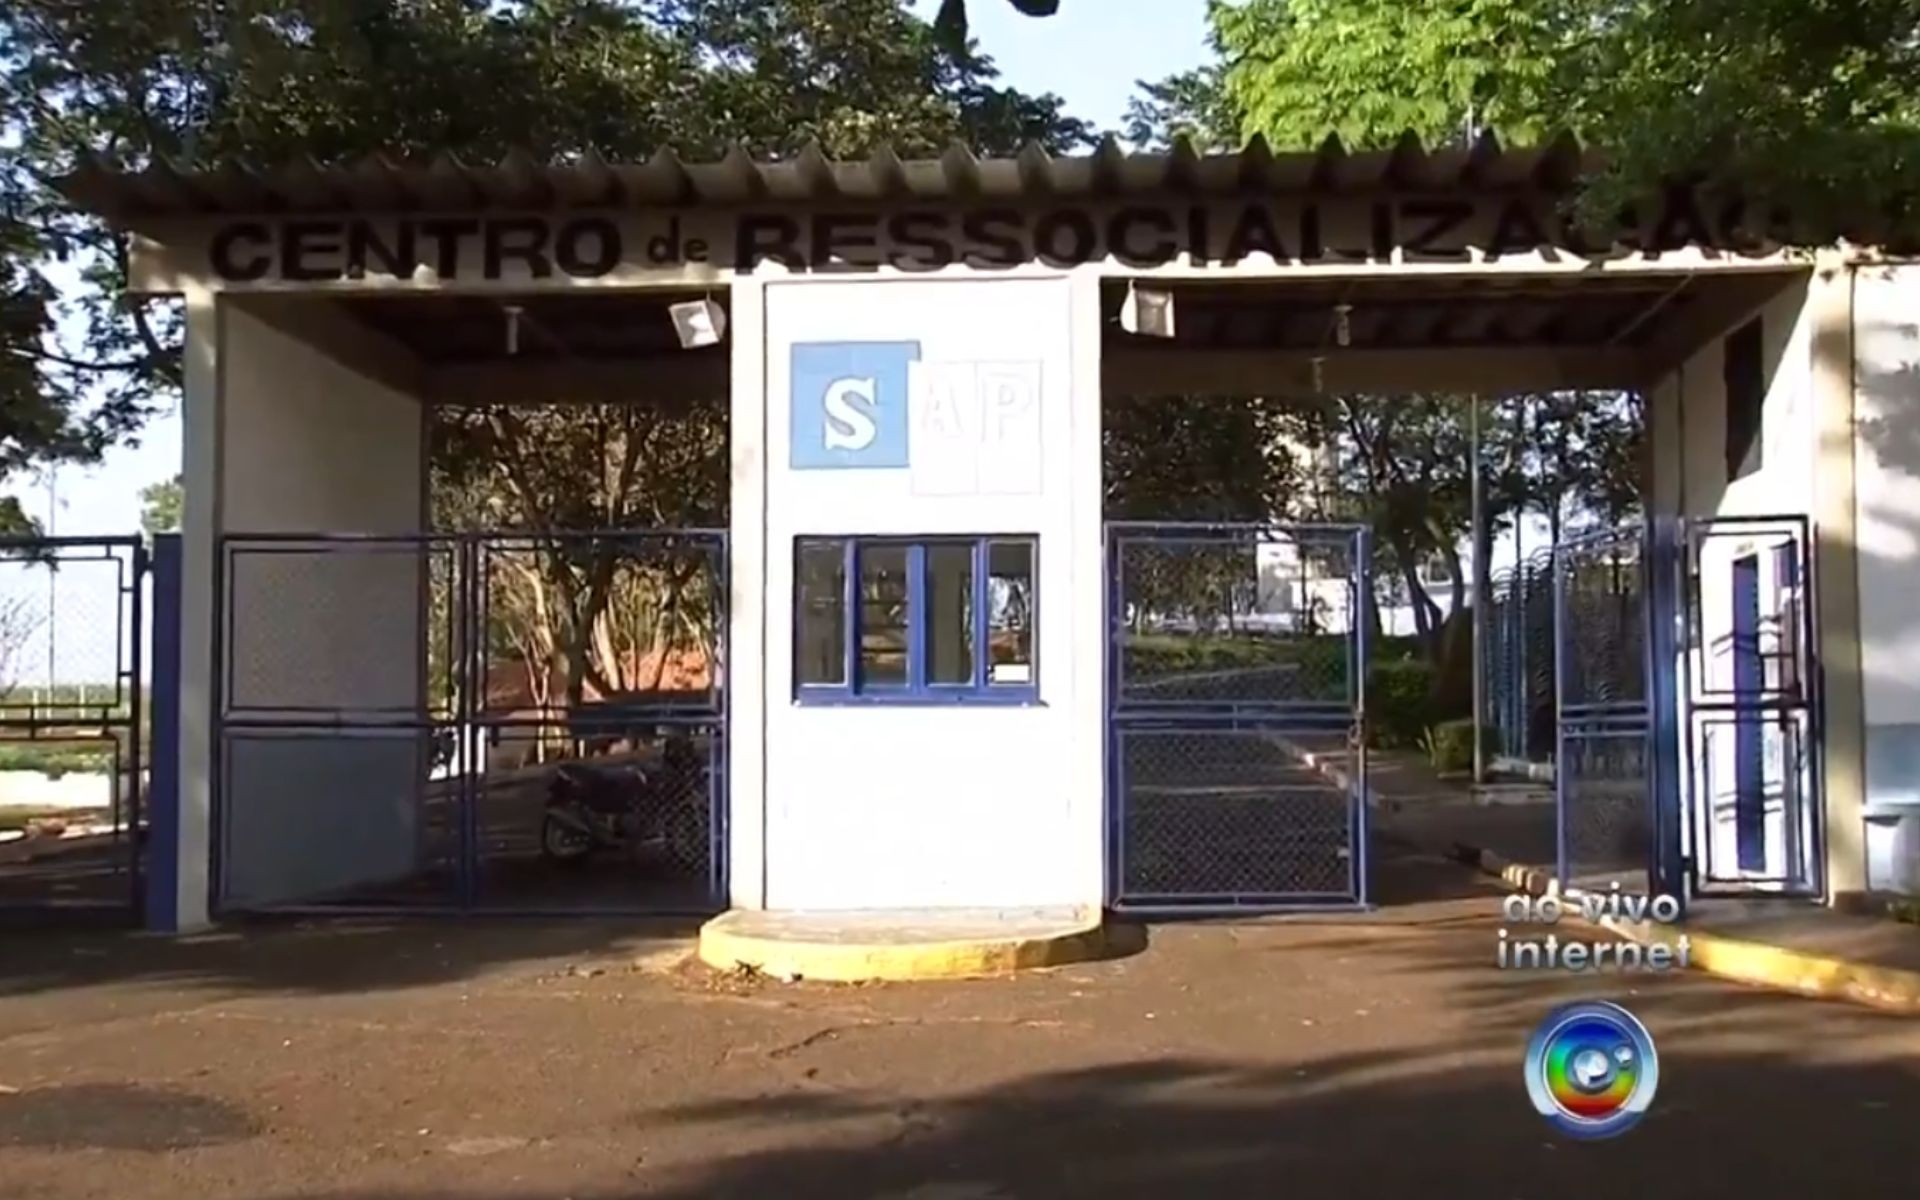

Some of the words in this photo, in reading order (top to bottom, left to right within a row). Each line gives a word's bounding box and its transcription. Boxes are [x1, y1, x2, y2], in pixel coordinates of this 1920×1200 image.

[210, 214, 624, 282] CENTRO
[646, 215, 710, 264] de
[822, 371, 1036, 452] SAP
